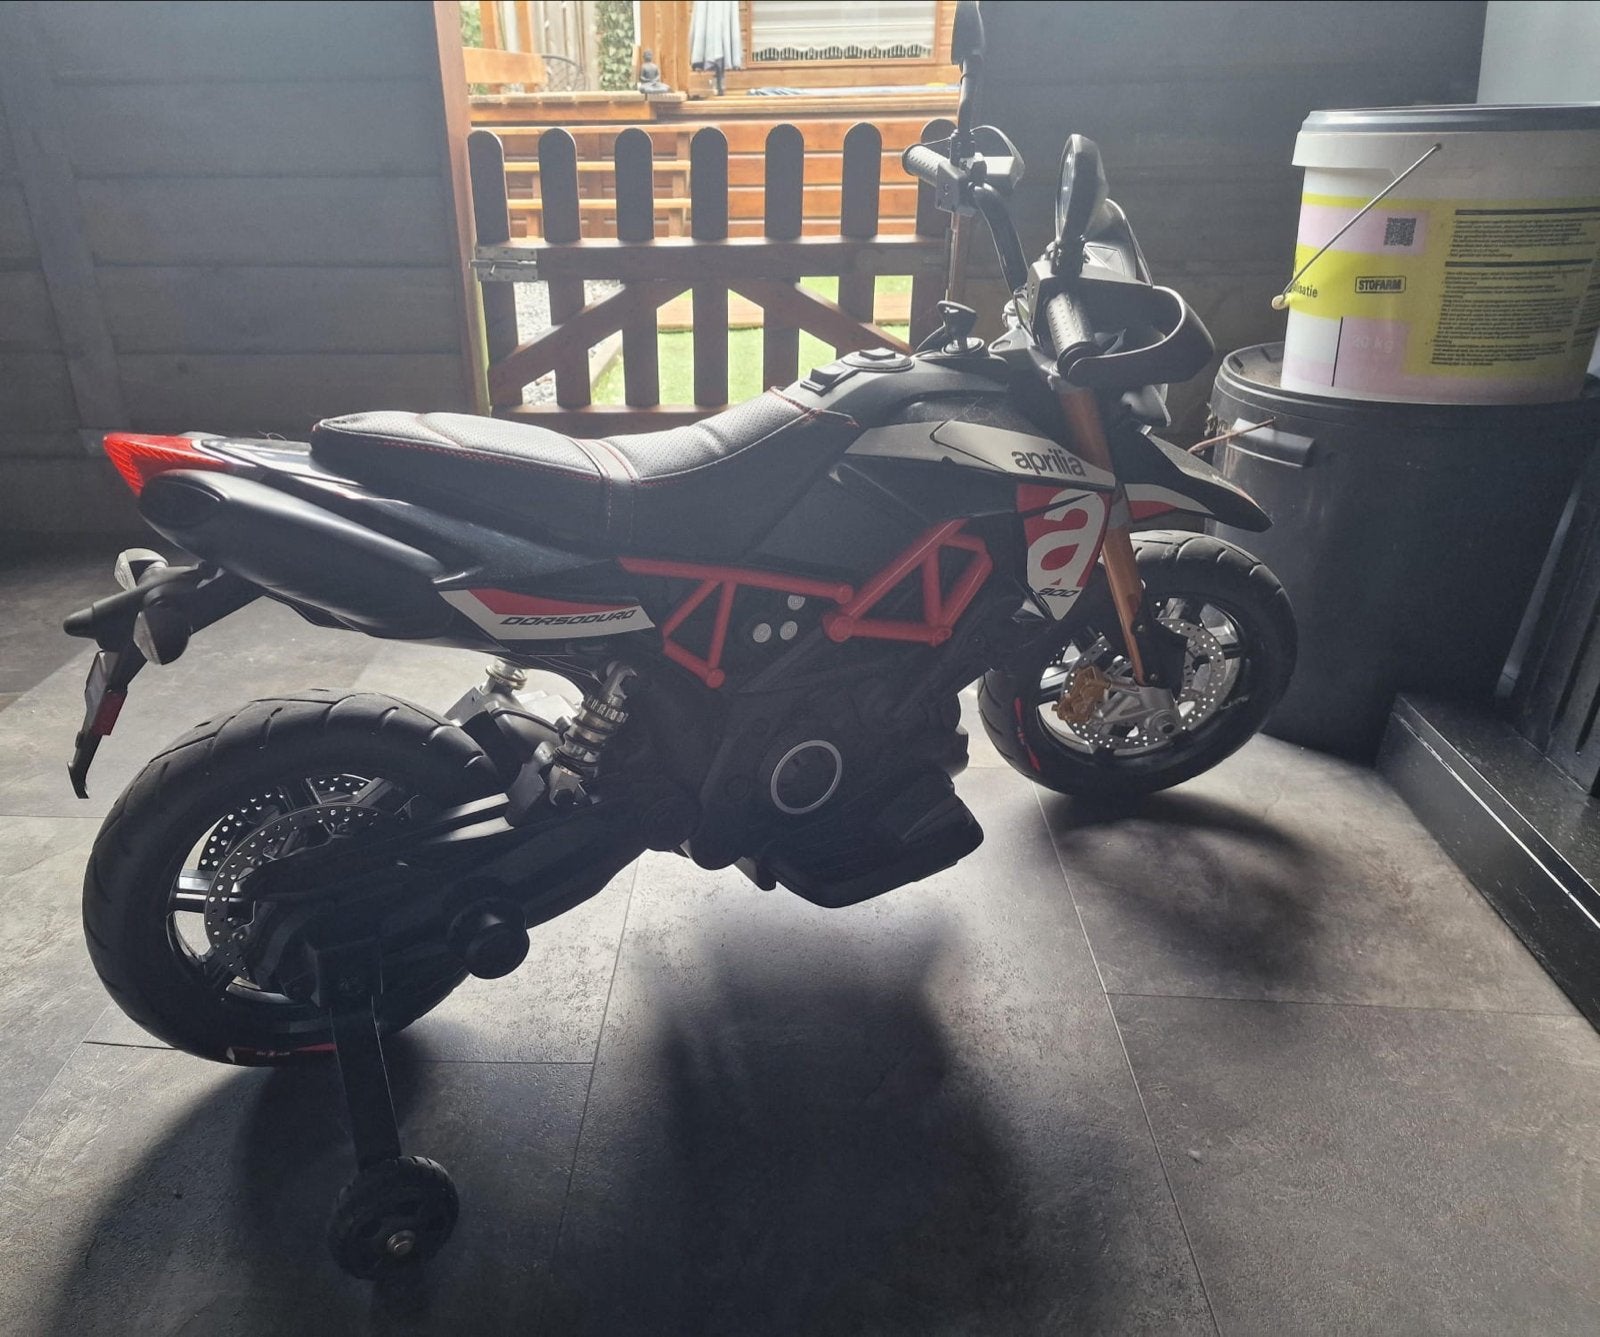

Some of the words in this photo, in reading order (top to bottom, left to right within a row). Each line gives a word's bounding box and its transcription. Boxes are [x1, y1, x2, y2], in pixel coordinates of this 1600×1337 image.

[1358, 279, 1402, 290] STOFARM
[1011, 448, 1086, 476] aprilia
[500, 609, 637, 626] DORSODURO
